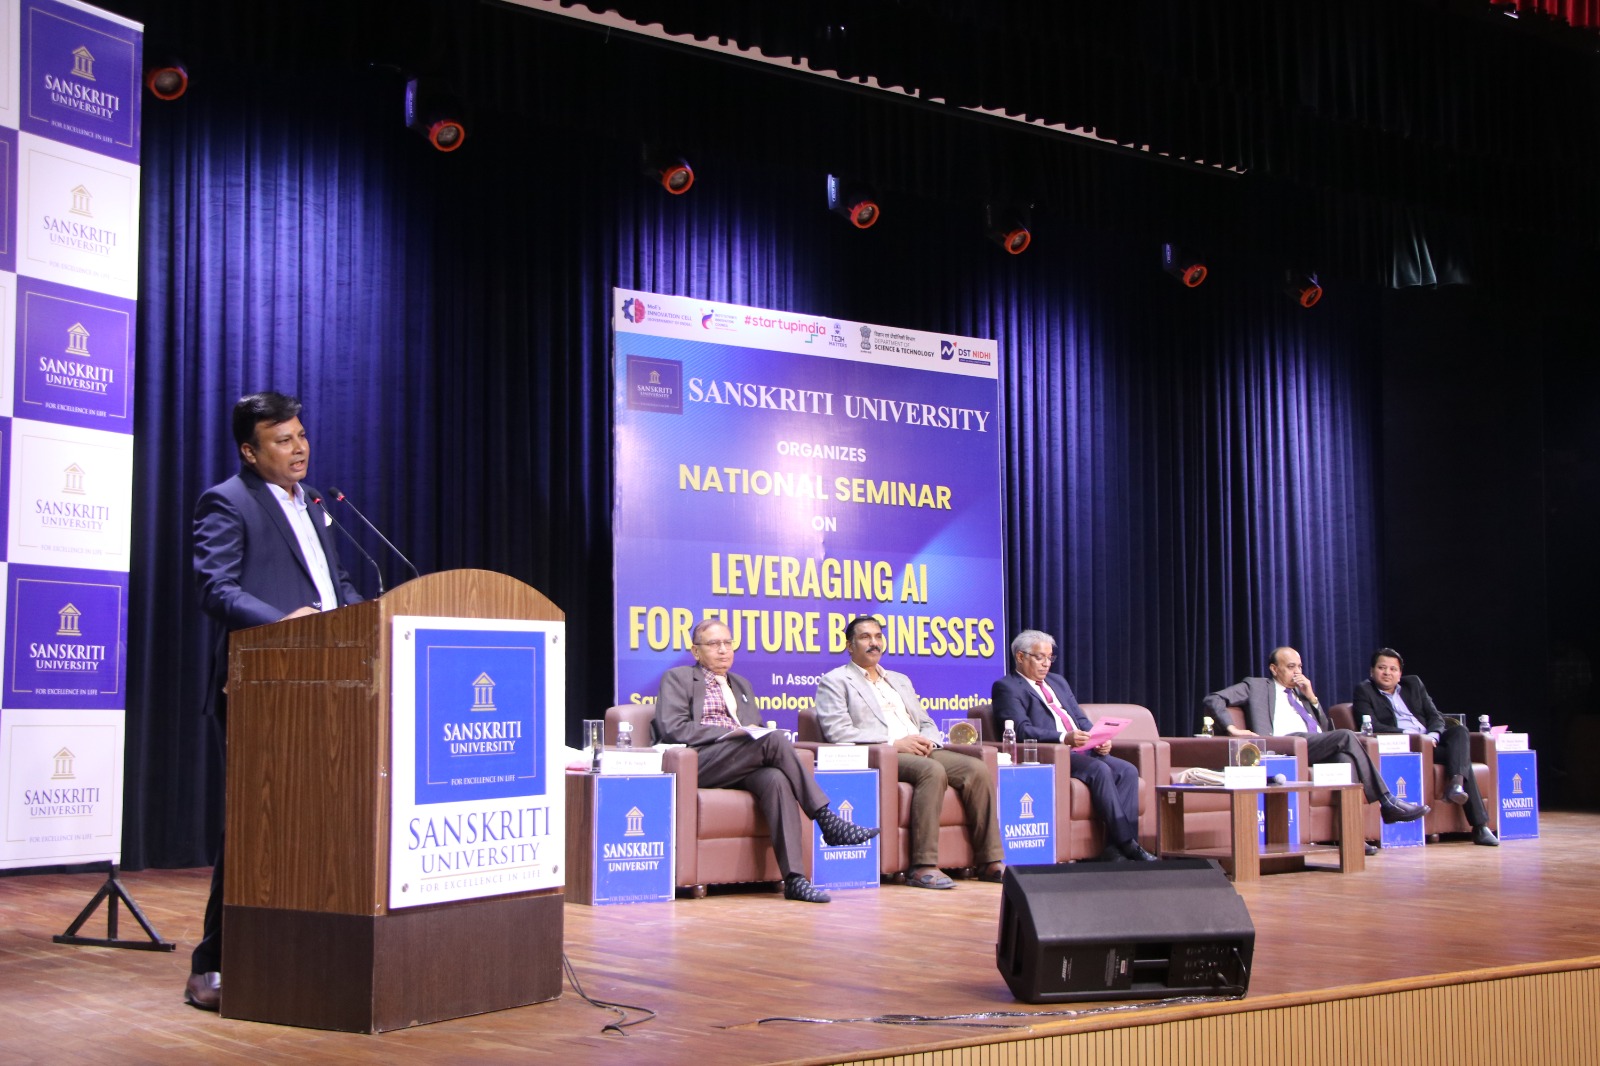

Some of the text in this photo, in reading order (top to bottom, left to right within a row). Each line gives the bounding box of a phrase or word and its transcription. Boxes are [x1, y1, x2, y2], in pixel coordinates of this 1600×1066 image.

[45, 74, 119, 111] SANSKRITI
[51, 92, 114, 119] UNIVERSITY
[51, 120, 63, 128] FOR
[63, 124, 94, 138] EXCELLENCE
[102, 135, 113, 144] LIFE
[43, 215, 116, 246] SANSKRITI
[50, 233, 111, 255] UNIVERSITY
[647, 310, 680, 320] INNOVATION
[744, 315, 826, 335] #startupindia
[874, 338, 903, 347] DEPARTMENT
[874, 344, 896, 352] SCIENCE
[901, 348, 934, 358] TECHNOLOGY
[958, 348, 990, 360] DST NIDHI
[39, 356, 114, 384] SANSKRITI
[46, 373, 108, 392] UNIVERSITY
[637, 384, 673, 395] SANSKRITI
[57, 404, 88, 414] EXCELLENCE
[96, 409, 107, 417] LIFE
[688, 377, 990, 433] SANSKRITI UNIVERSITY
[776, 440, 867, 463] ORGANIZES
[679, 464, 952, 509] NATIONAL SEMINAR
[35, 499, 109, 521] SANSKRITI
[42, 515, 103, 530] UNIVERSITY
[811, 515, 837, 532] ON
[711, 553, 928, 604] LEVERAGING AI
[629, 606, 694, 650] FOR
[828, 612, 995, 657] BSINESSES
[29, 642, 106, 660] SANSKRITI
[36, 660, 99, 670] UNIVERSITY
[772, 673, 784, 685] In
[48, 688, 80, 696] EXCELLENCE
[443, 721, 522, 741] SANSKRITI
[450, 740, 516, 754] UNIVERSITY
[451, 778, 463, 786] FOR
[464, 776, 496, 784] EXCELLENCE
[505, 774, 516, 782] LIFE
[24, 787, 100, 805] SANSKRITI
[1502, 797, 1534, 809] SANSKRITI
[30, 804, 94, 816] UNIVERSITY
[1505, 810, 1532, 818] UNIVERSITY
[408, 806, 551, 851] SANSKRITI
[1004, 822, 1049, 838] SANSKRITI
[603, 841, 665, 858] SANSKRITI
[1008, 838, 1046, 850] UNIVERSITY
[421, 842, 540, 874] UNIVERSITY
[824, 850, 868, 860] UNIVERSITY
[608, 860, 660, 872] UNIVERSITY
[420, 869, 541, 893] FOR EXCELLENCE IN LIFE
